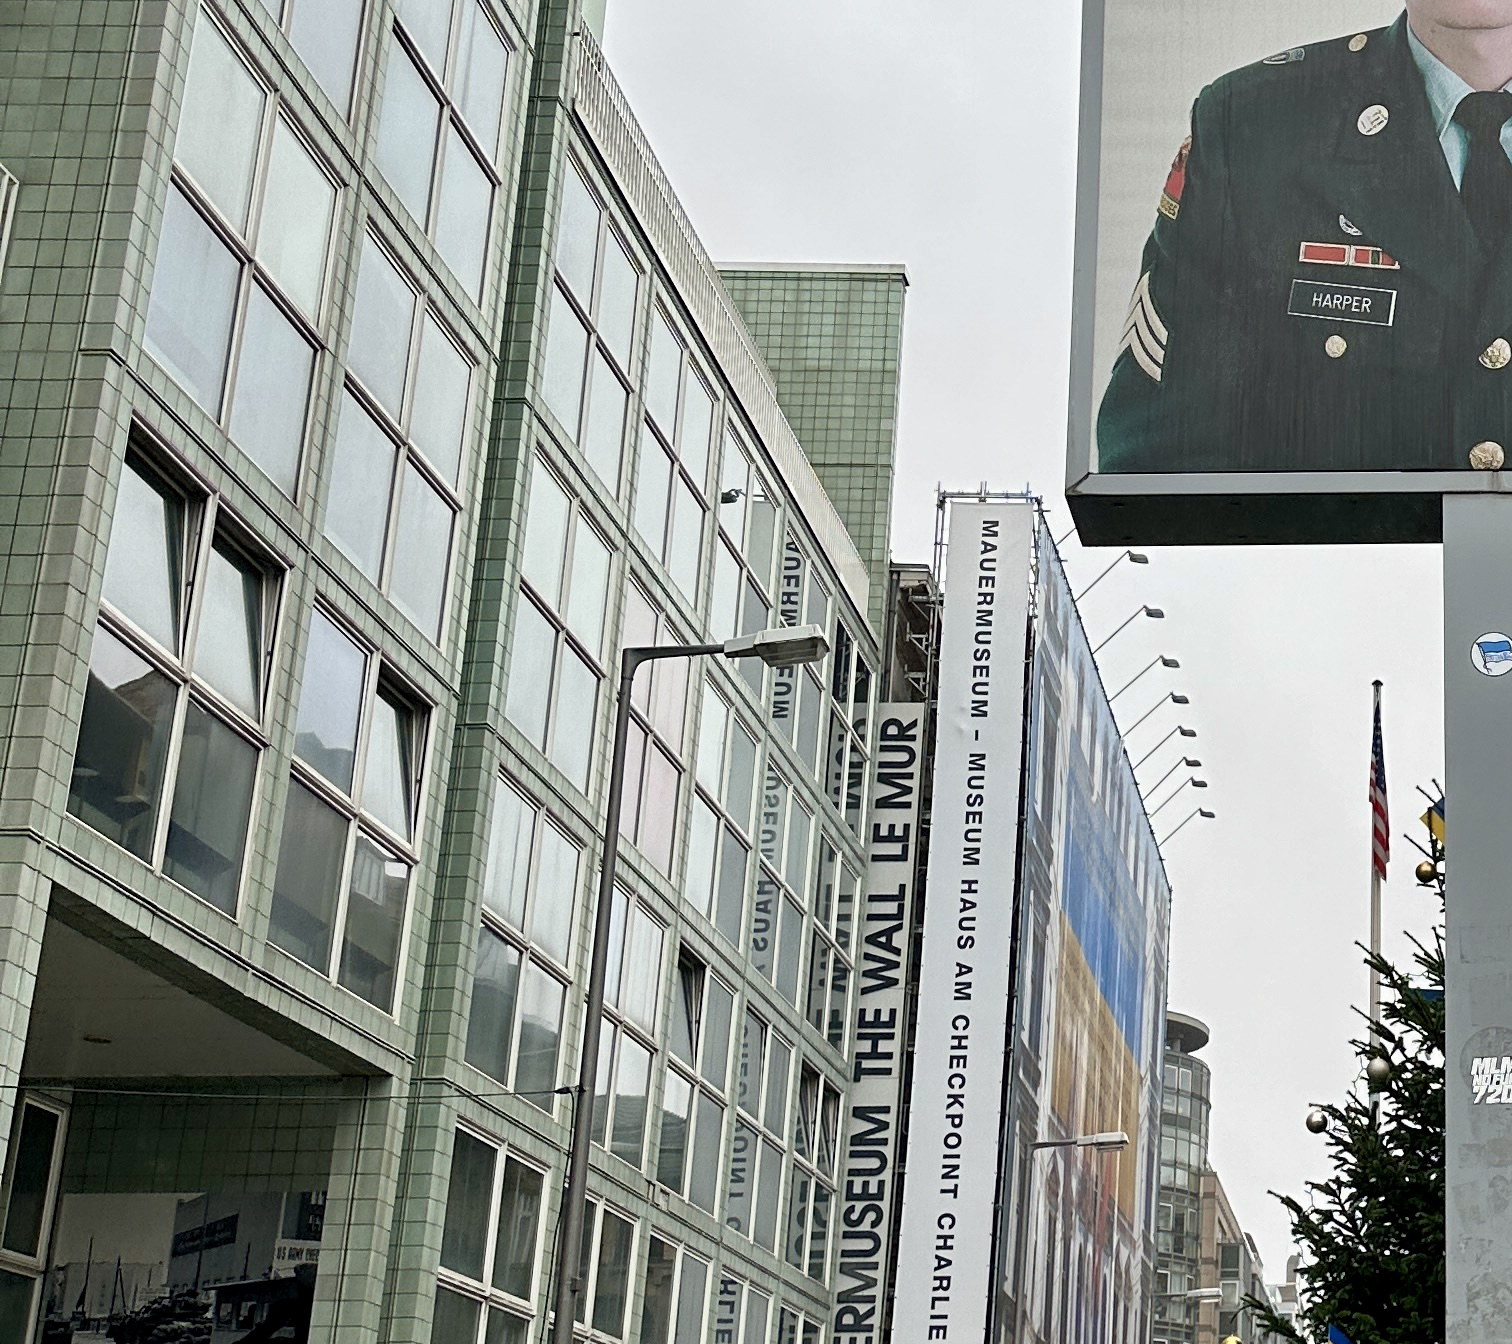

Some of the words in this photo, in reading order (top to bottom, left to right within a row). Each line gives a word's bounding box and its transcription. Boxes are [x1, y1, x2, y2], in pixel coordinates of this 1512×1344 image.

[1312, 292, 1372, 313] HARPER
[970, 519, 999, 719] MAUERMUSEUM
[875, 717, 919, 809] MUR
[870, 822, 910, 862] LE
[962, 752, 986, 867] MUSEUM
[860, 883, 906, 996] WALL
[956, 879, 979, 950] HAUS
[953, 961, 974, 1001] AM
[853, 1008, 896, 1083] THE
[939, 1014, 971, 1199] CHECKPOINT
[927, 1212, 956, 1341] CHARLIE
